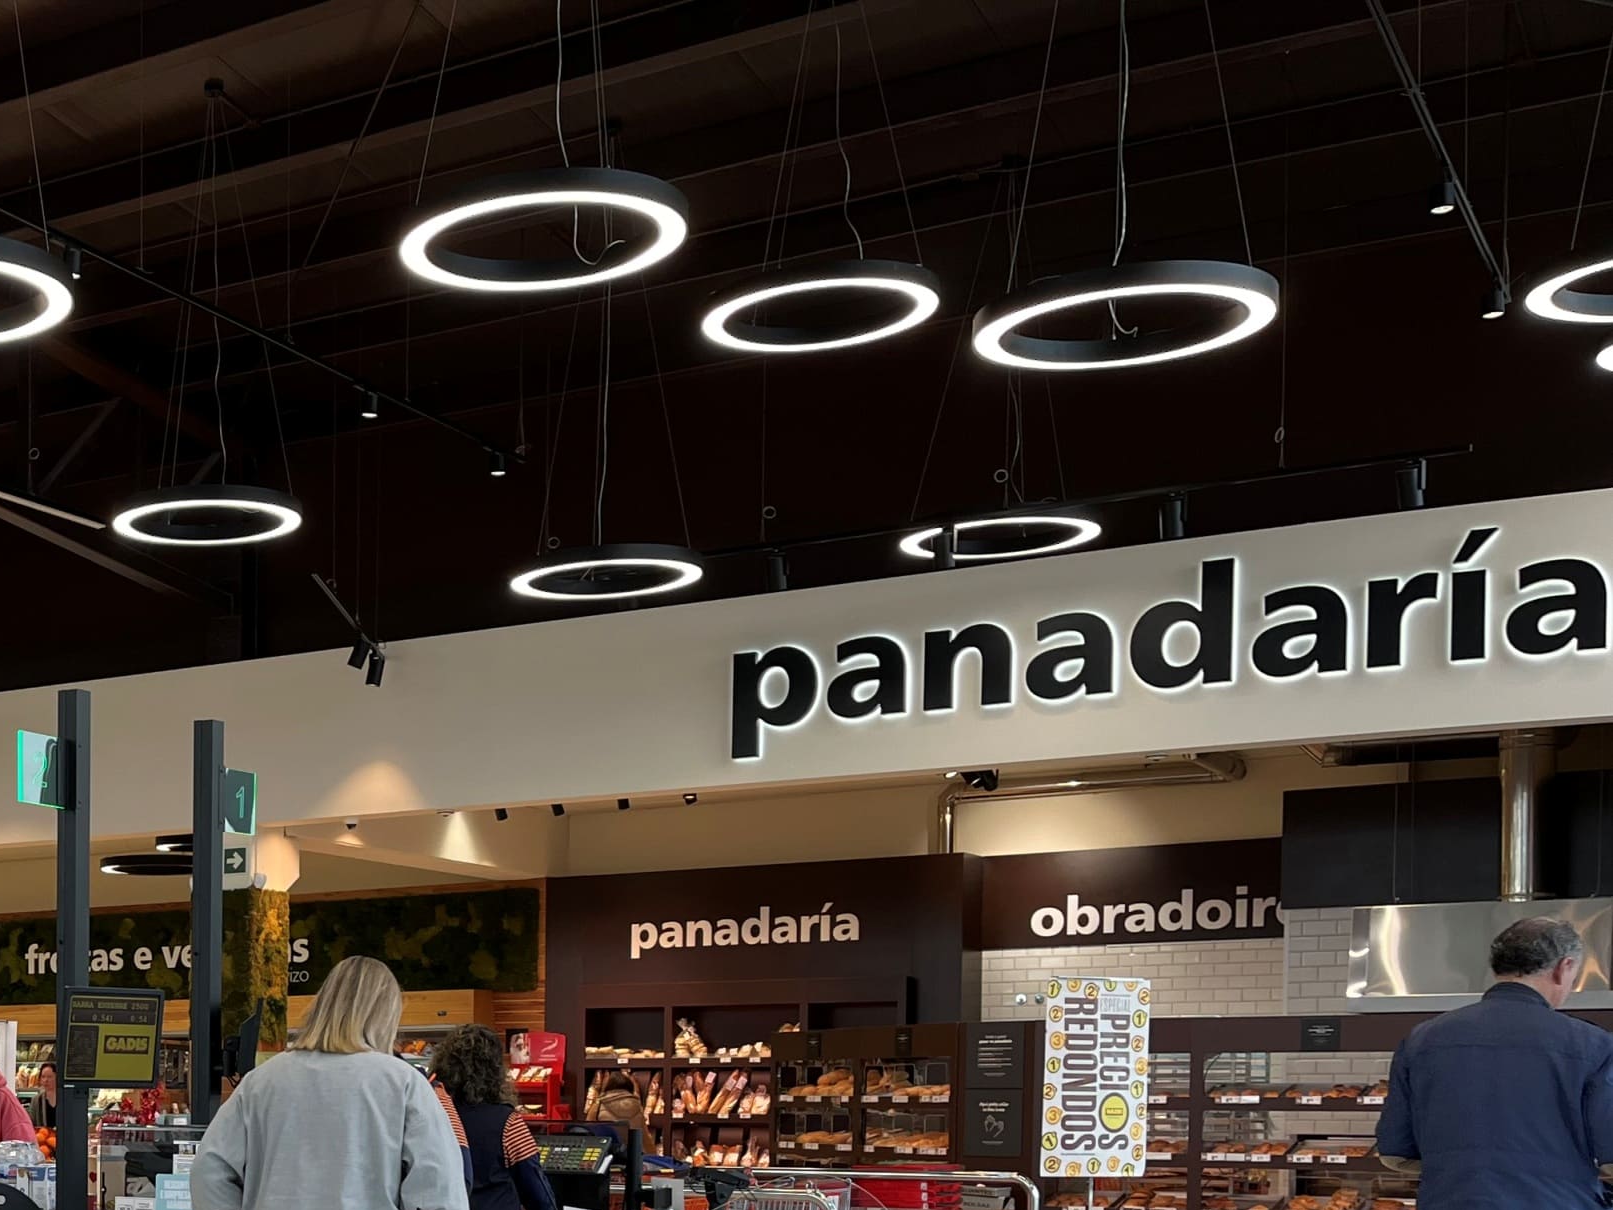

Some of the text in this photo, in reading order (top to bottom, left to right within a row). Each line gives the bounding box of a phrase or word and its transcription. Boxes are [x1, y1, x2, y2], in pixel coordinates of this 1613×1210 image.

[730, 527, 1609, 759] panadaría
[32, 751, 48, 789] 2
[235, 785, 245, 819] 1
[630, 902, 860, 959] panadaría
[133, 946, 153, 971] e
[106, 1036, 148, 1052] GADIS
[1061, 998, 1099, 1150] REDONDOS
